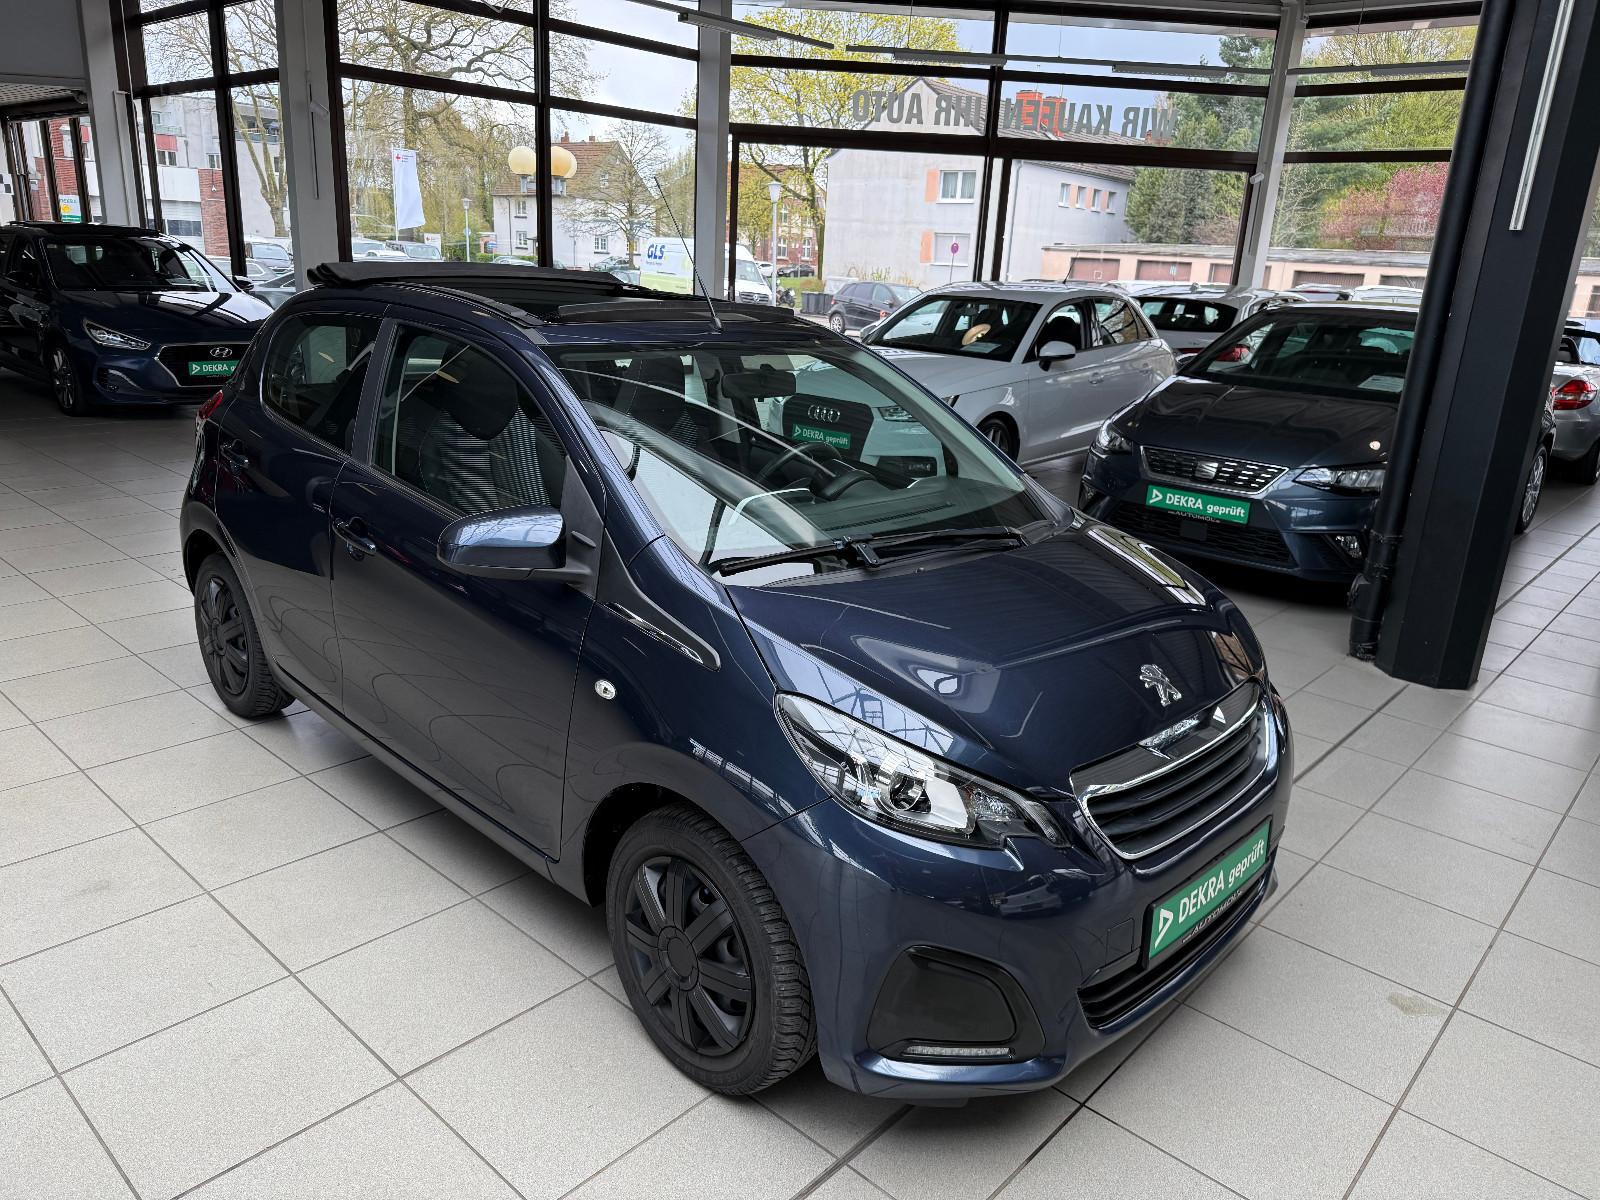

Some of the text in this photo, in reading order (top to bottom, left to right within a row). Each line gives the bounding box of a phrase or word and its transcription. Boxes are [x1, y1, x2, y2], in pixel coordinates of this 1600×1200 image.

[647, 243, 666, 259] GLS
[202, 363, 229, 372] DEKRA
[802, 429, 824, 440] DEKRA
[1166, 493, 1246, 517] DEKRA geprüft
[1178, 838, 1265, 924] DEKRA geprüft
